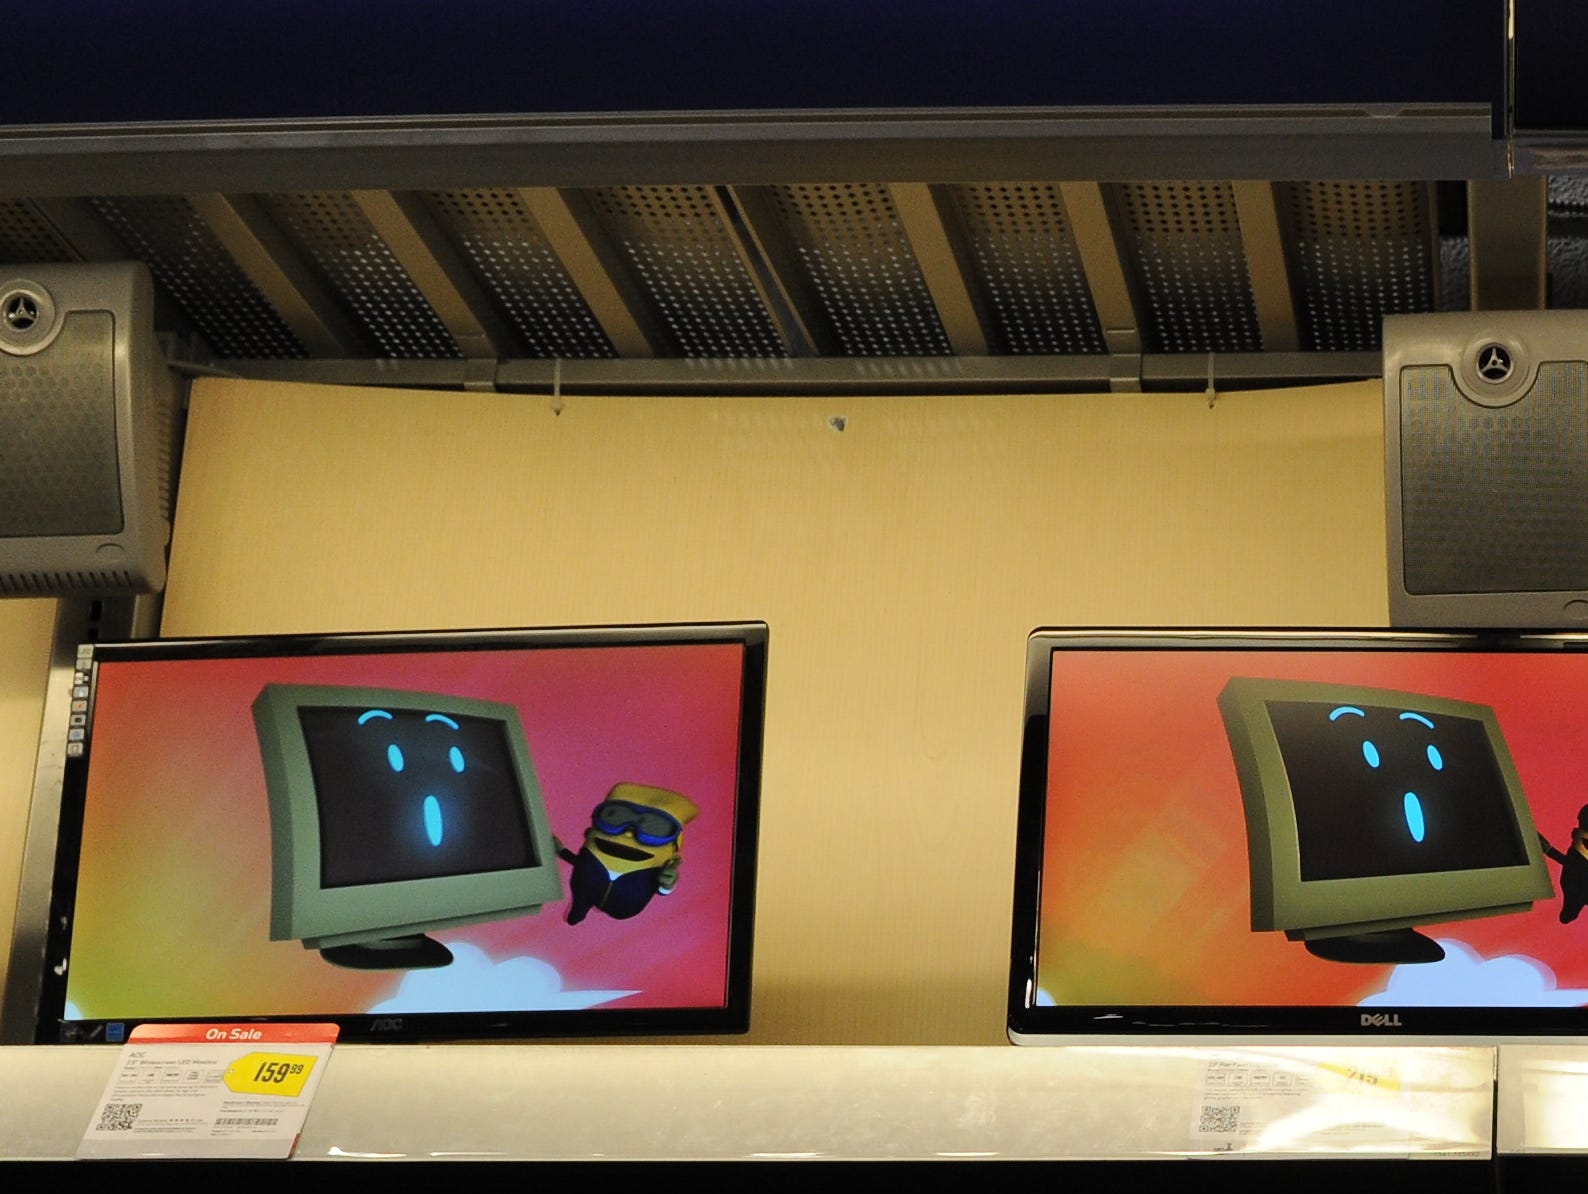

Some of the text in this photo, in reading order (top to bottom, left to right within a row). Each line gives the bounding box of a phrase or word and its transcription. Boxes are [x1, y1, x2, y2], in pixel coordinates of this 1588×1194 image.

[1361, 1013, 1402, 1027] DELL
[205, 1028, 262, 1040] On Sale
